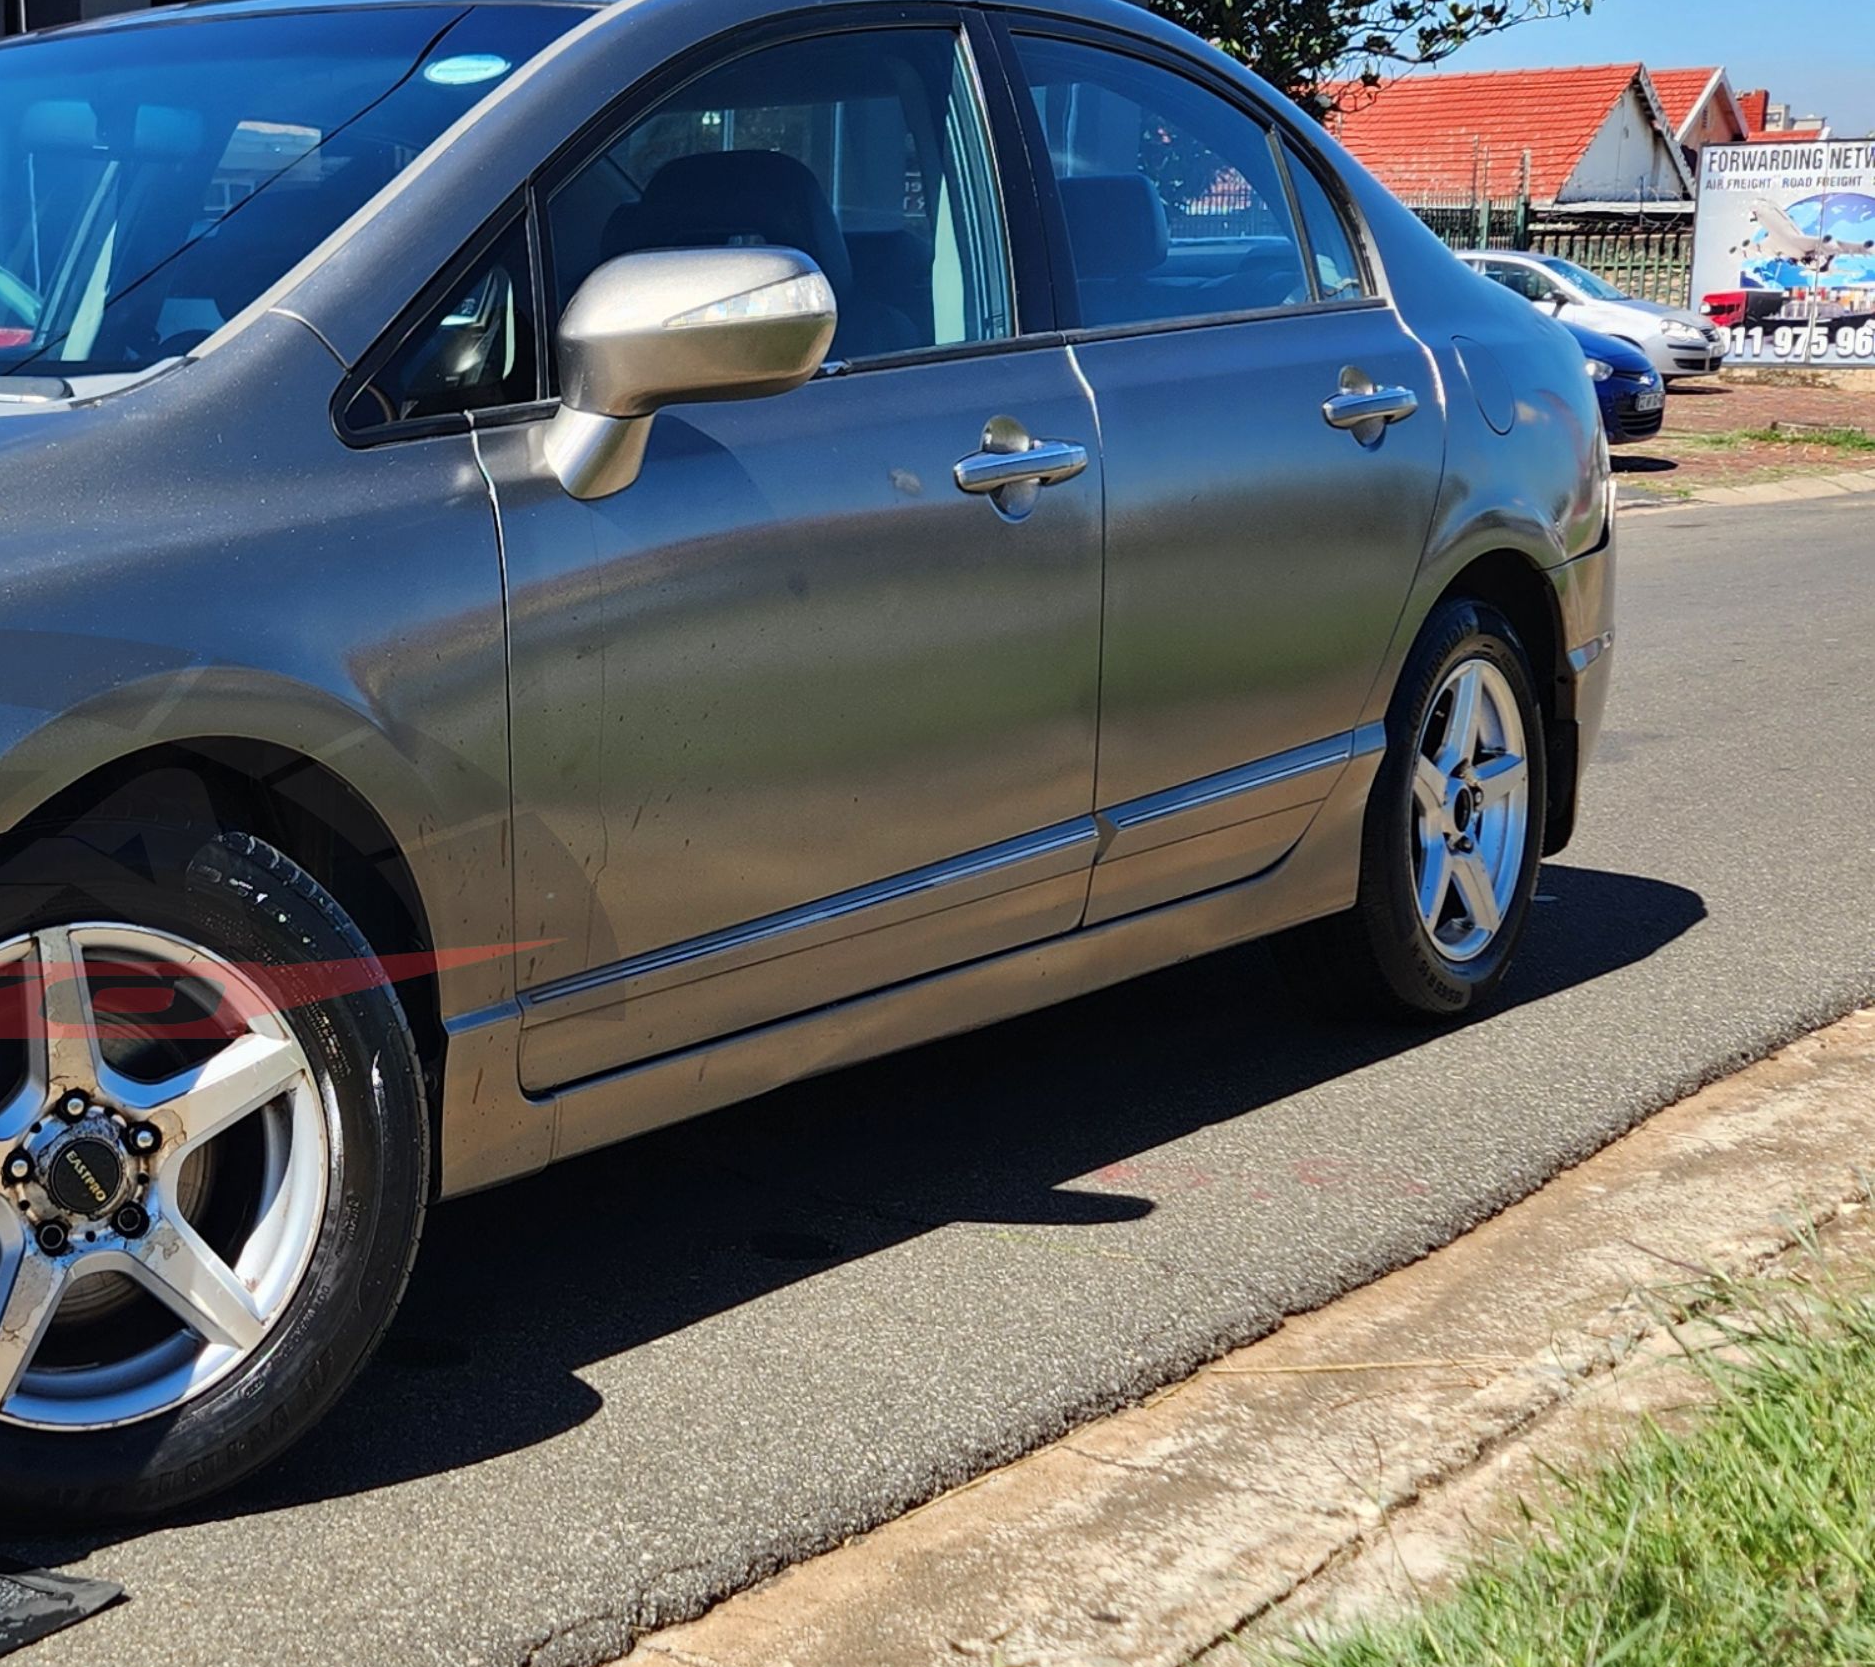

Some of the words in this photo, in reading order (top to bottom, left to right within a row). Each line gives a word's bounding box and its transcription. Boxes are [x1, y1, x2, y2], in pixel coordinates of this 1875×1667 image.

[1708, 147, 1824, 172] FORWARDING
[1706, 179, 1724, 190] AIR
[1726, 178, 1772, 190] FREIGHT
[1782, 177, 1813, 188] ROAD
[1816, 176, 1862, 187] FREIGHT
[1774, 325, 1828, 357] 975
[1836, 325, 1875, 357] 96
[65, 1150, 107, 1203] EASTPRO
